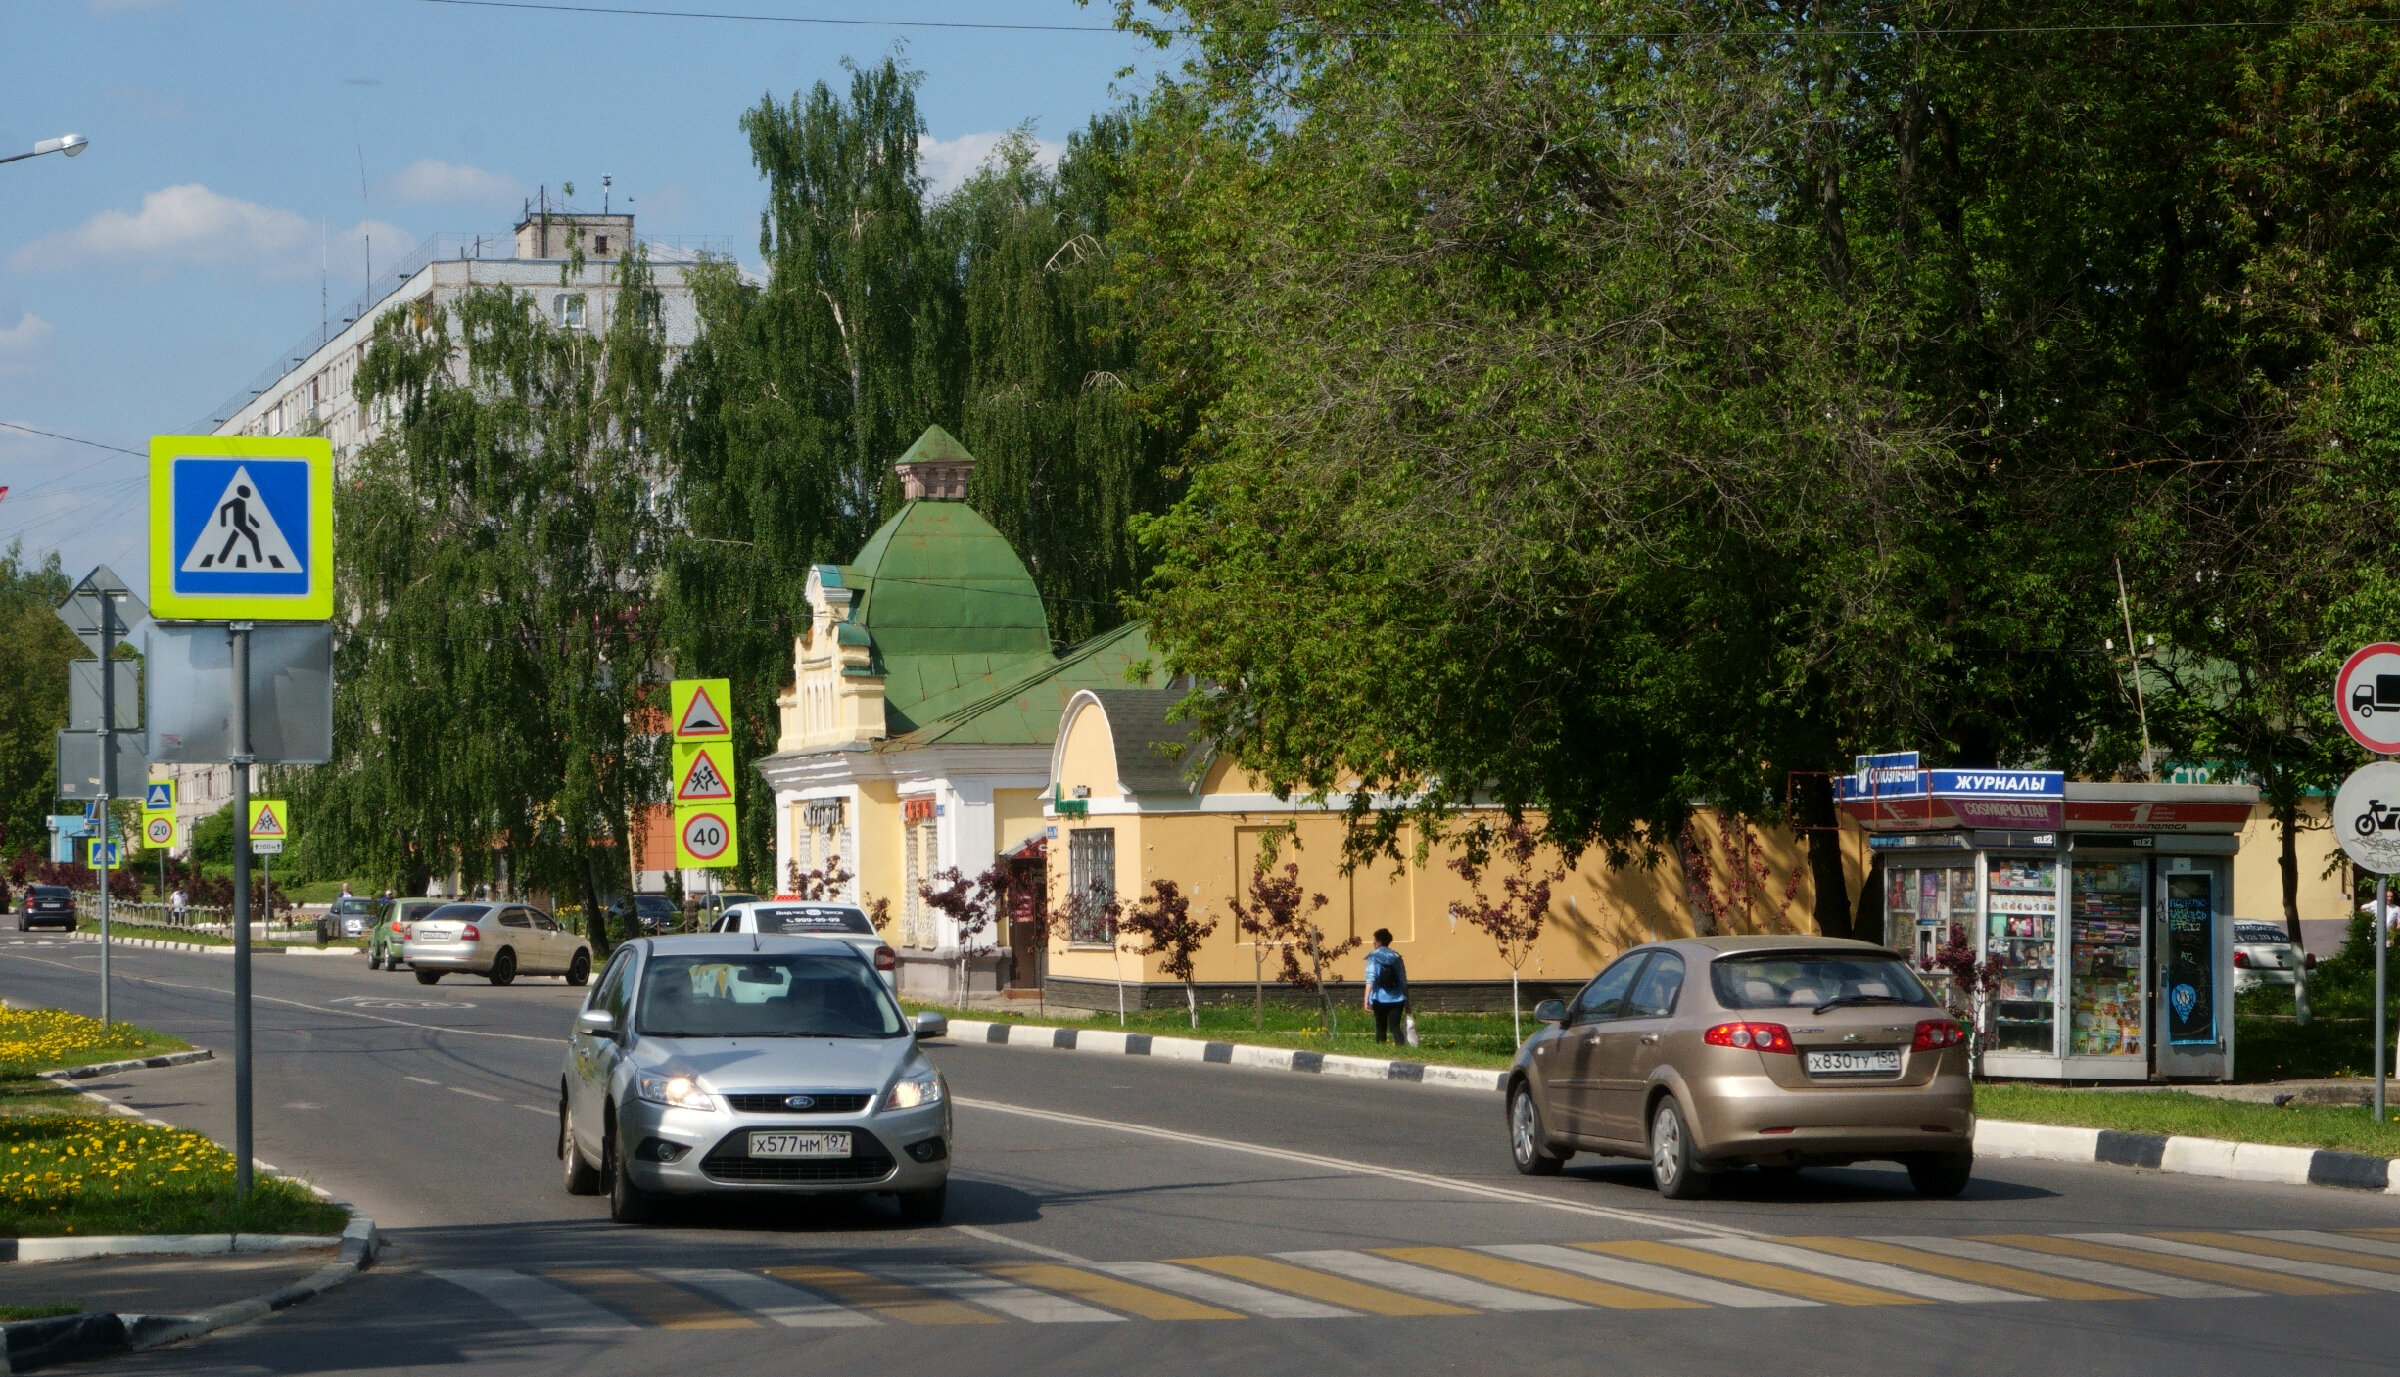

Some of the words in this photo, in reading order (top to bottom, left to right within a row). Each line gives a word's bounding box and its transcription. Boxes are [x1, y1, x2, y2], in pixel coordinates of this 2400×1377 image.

[1955, 775, 2046, 791] ЖУРНАЛЫ
[1964, 802, 2049, 818] COSMOPOLITAN
[153, 825, 167, 836] 20
[693, 827, 720, 846] 40
[2033, 834, 2053, 844] TELE2
[2132, 838, 2152, 848] TELE2
[1874, 1051, 1896, 1063] 150
[823, 1134, 846, 1148] 197
